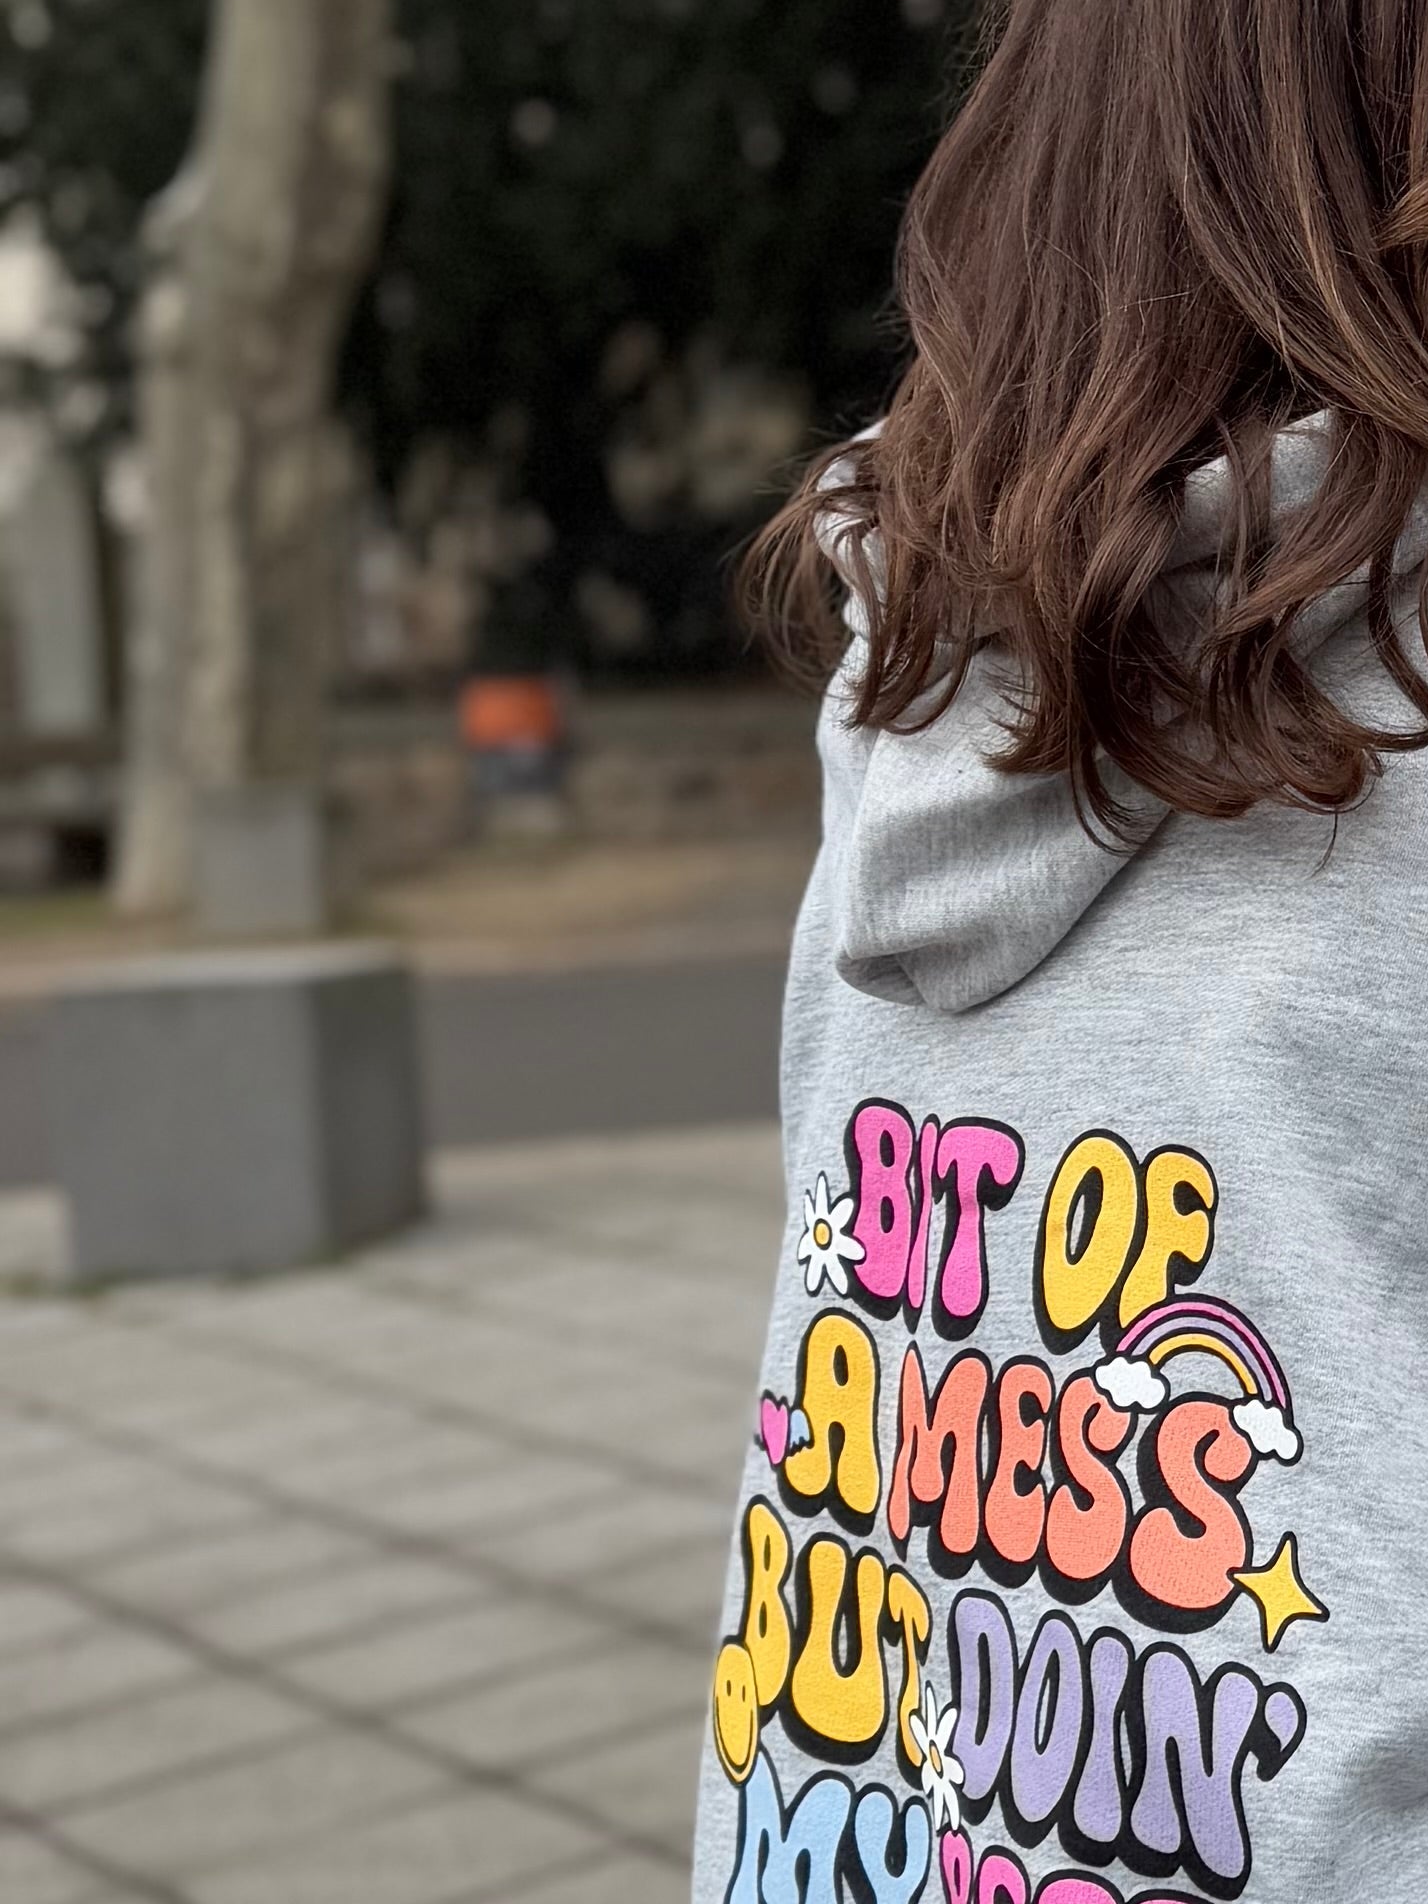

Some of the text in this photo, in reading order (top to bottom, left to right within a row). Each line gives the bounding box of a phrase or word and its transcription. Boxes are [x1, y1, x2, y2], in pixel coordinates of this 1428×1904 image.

[844, 1097, 1219, 1345] BIT OF
[785, 1307, 1256, 1631] A MESS
[739, 1504, 1308, 1896] BUT DOIN'
